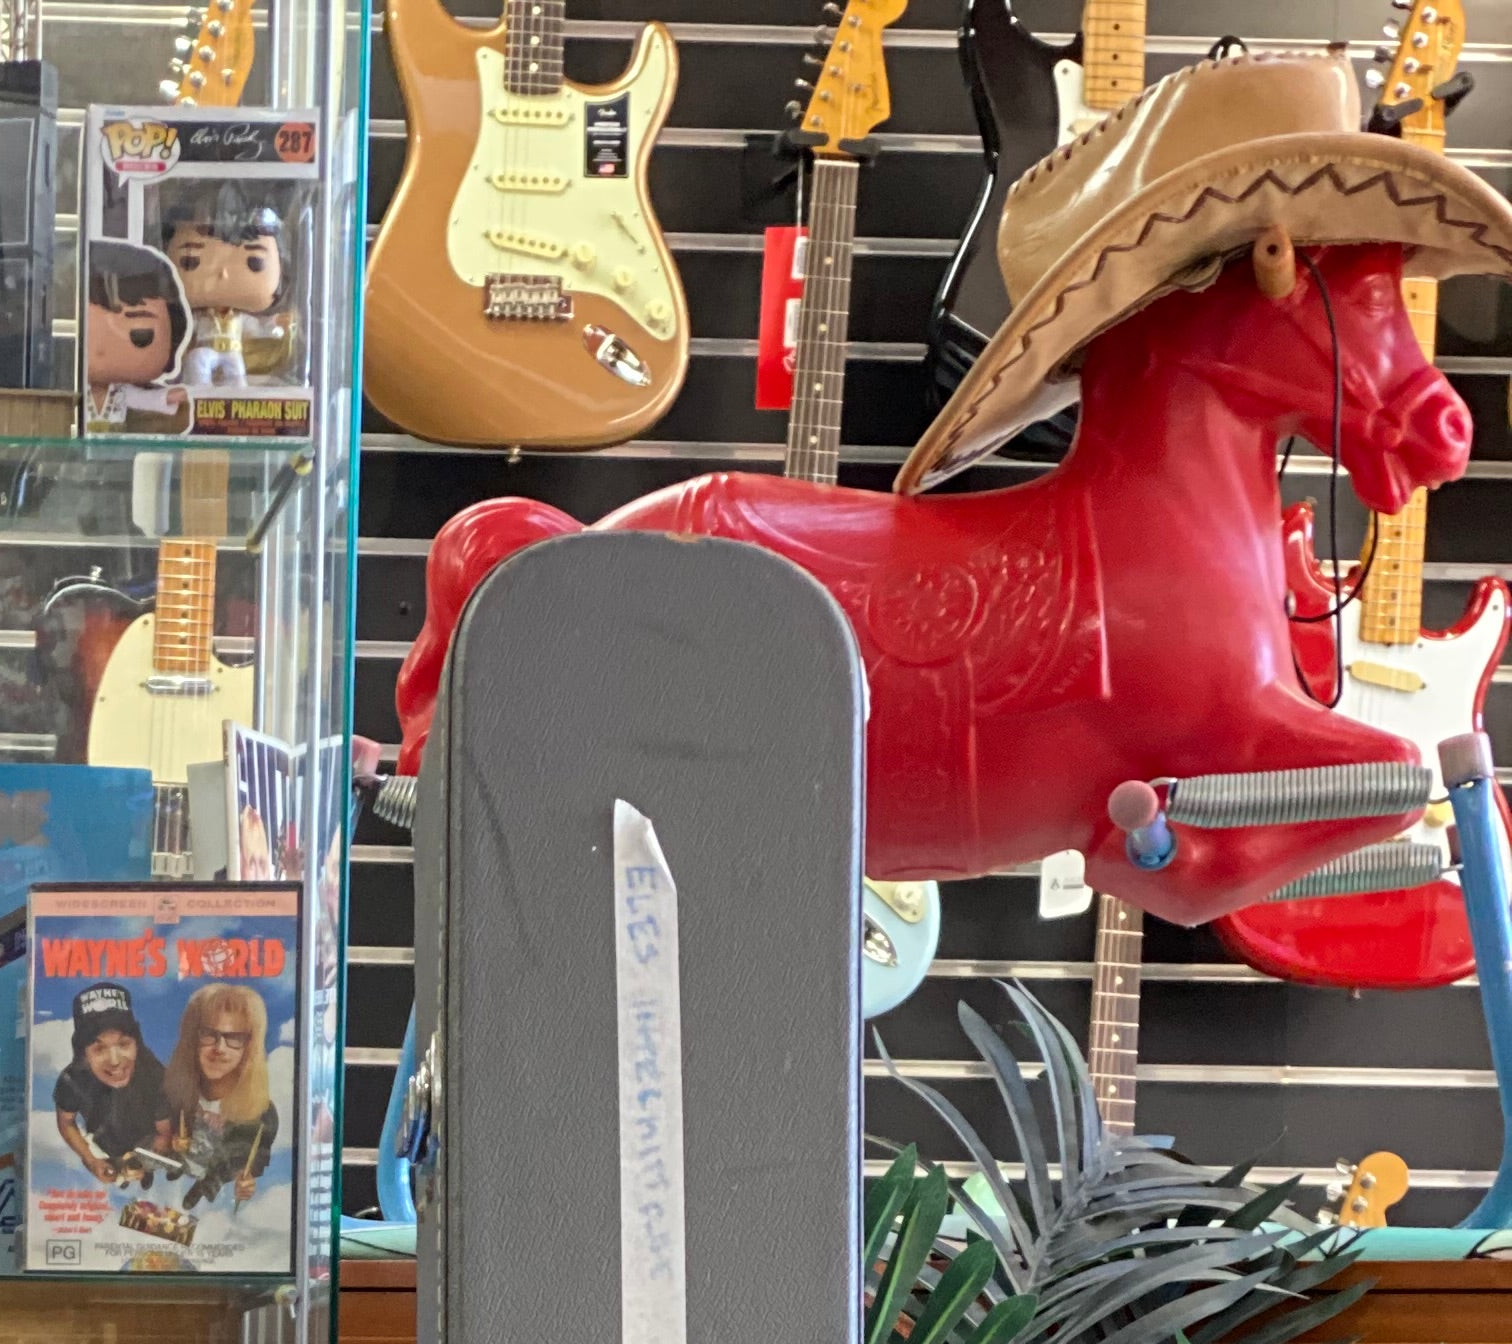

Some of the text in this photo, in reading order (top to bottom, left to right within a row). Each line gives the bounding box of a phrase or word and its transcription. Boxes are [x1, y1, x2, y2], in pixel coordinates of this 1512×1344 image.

[100, 121, 178, 160] POP!
[279, 131, 314, 153] 287
[197, 401, 309, 419] ELVIS PHARAOH SUIT
[56, 899, 276, 909] WIDESCREEN COLLECTION
[41, 928, 286, 980] WAYNE'S WORLD
[51, 1246, 76, 1260] PG
